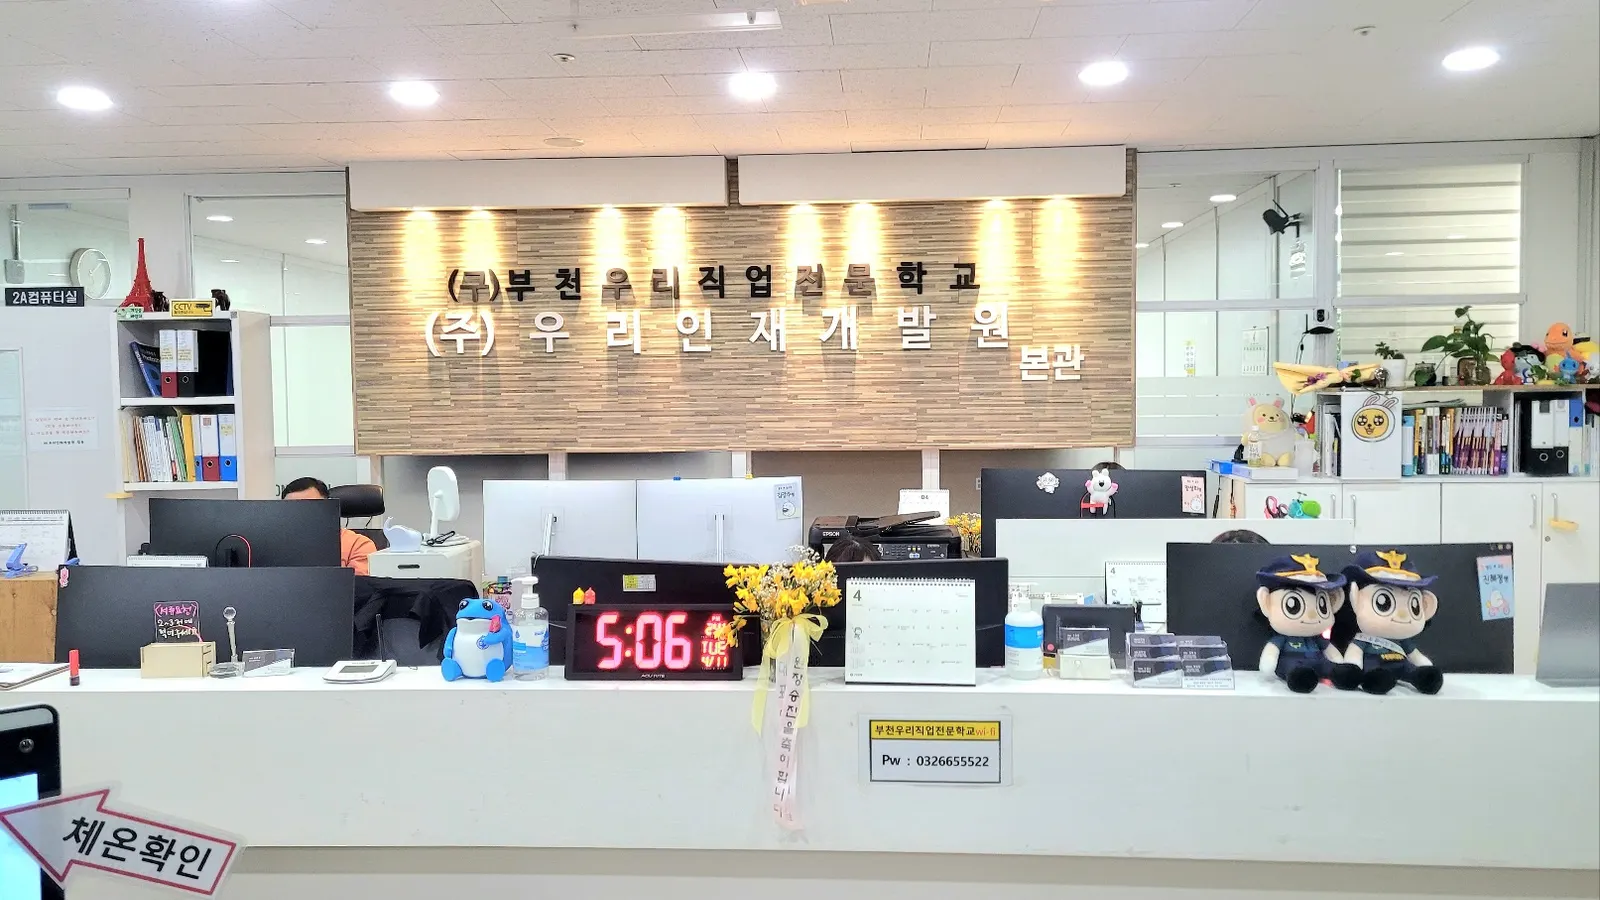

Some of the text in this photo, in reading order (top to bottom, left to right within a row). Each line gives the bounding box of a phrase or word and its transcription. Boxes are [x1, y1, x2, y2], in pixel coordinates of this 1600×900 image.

[12, 290, 77, 305] 2A컴퓨터실
[173, 303, 192, 311] CCTV
[1019, 345, 1085, 381] 본관
[1110, 567, 1116, 575] 4
[852, 589, 862, 602] 4
[595, 611, 692, 670] 5:06
[701, 640, 727, 656] TUE
[701, 656, 727, 668] 4/11
[882, 754, 901, 766] Pw
[916, 755, 989, 767] 0326655522
[62, 816, 212, 880] 체온확인
